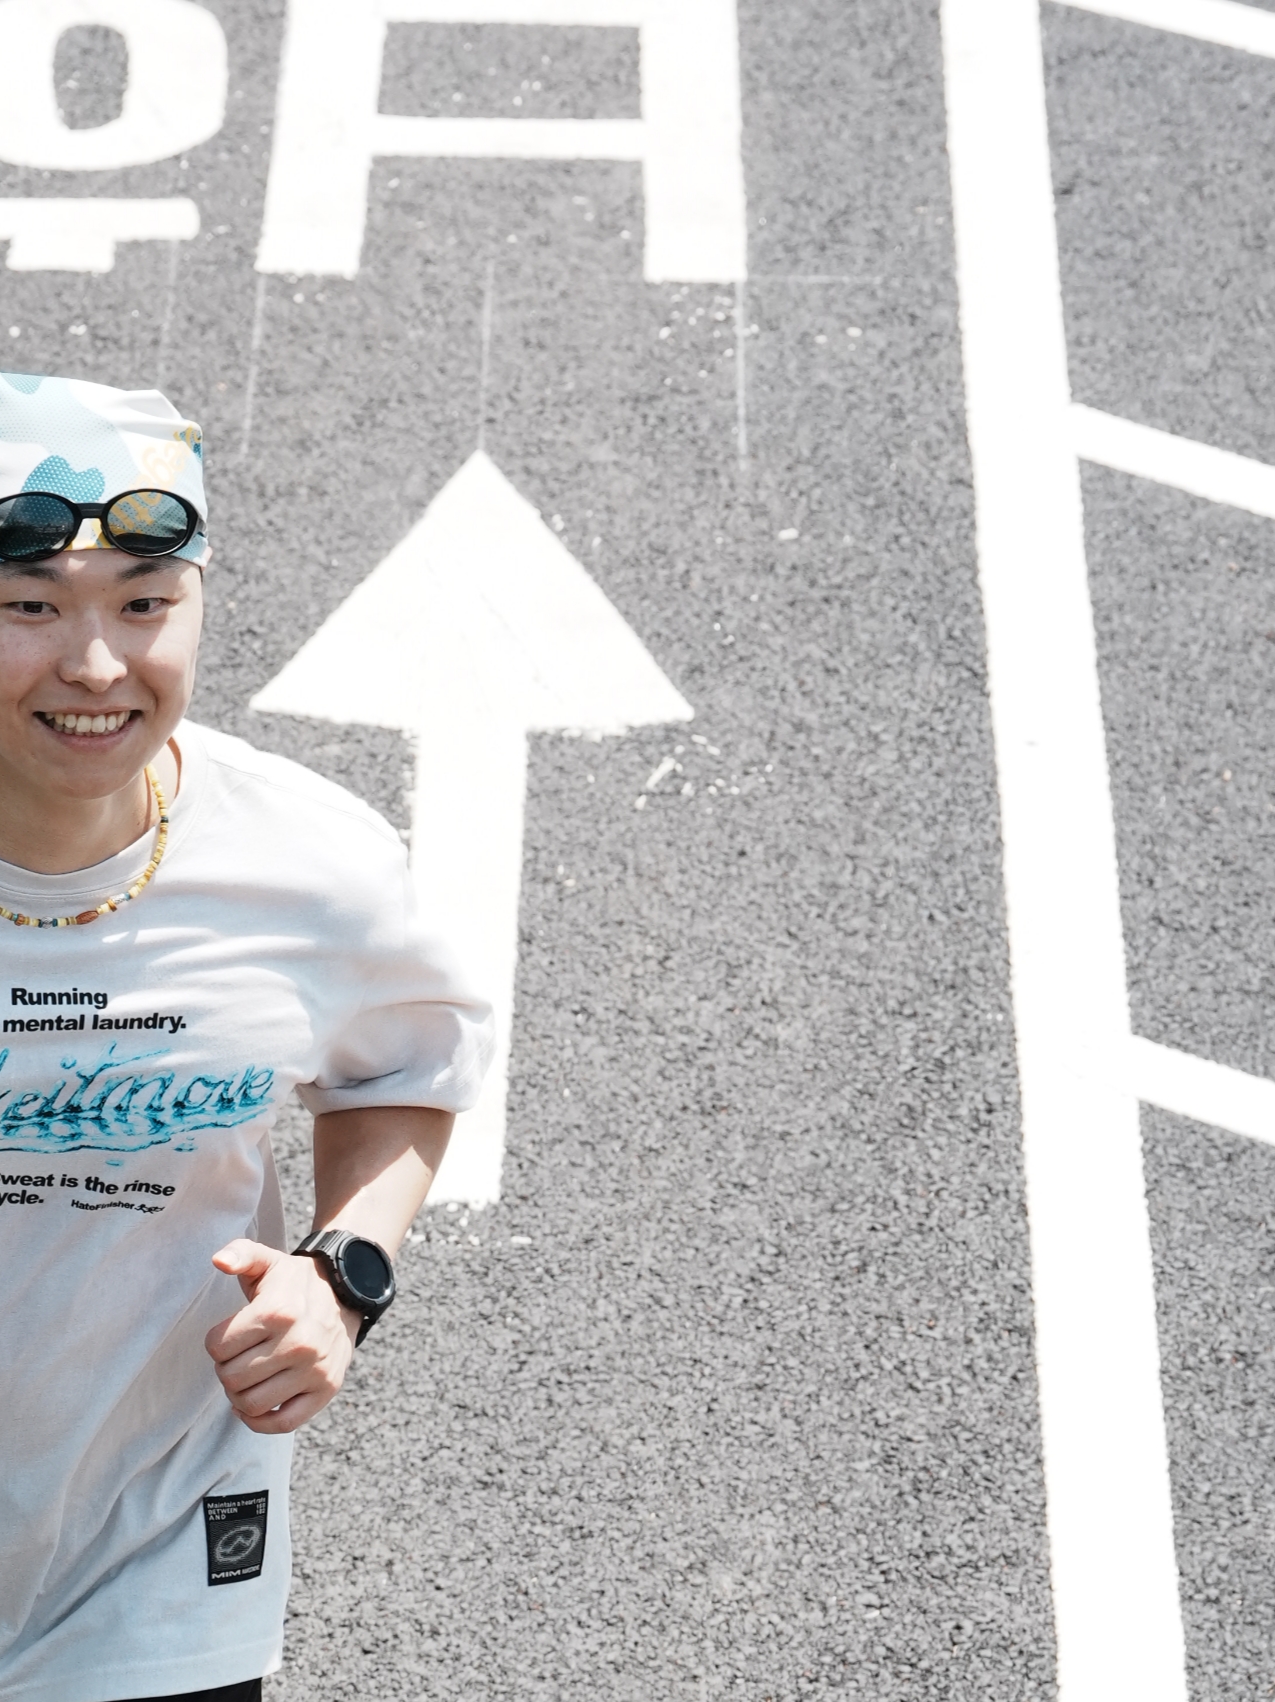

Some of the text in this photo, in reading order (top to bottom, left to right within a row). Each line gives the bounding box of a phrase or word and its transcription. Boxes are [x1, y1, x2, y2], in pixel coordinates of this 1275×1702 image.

[10, 987, 109, 1010] Running
[2, 1014, 86, 1033] mental
[91, 1012, 187, 1034] laundry.
[59, 1174, 79, 1188] is
[84, 1176, 119, 1195] the
[123, 1179, 176, 1197] rinse
[211, 1569, 241, 1579] MIM
